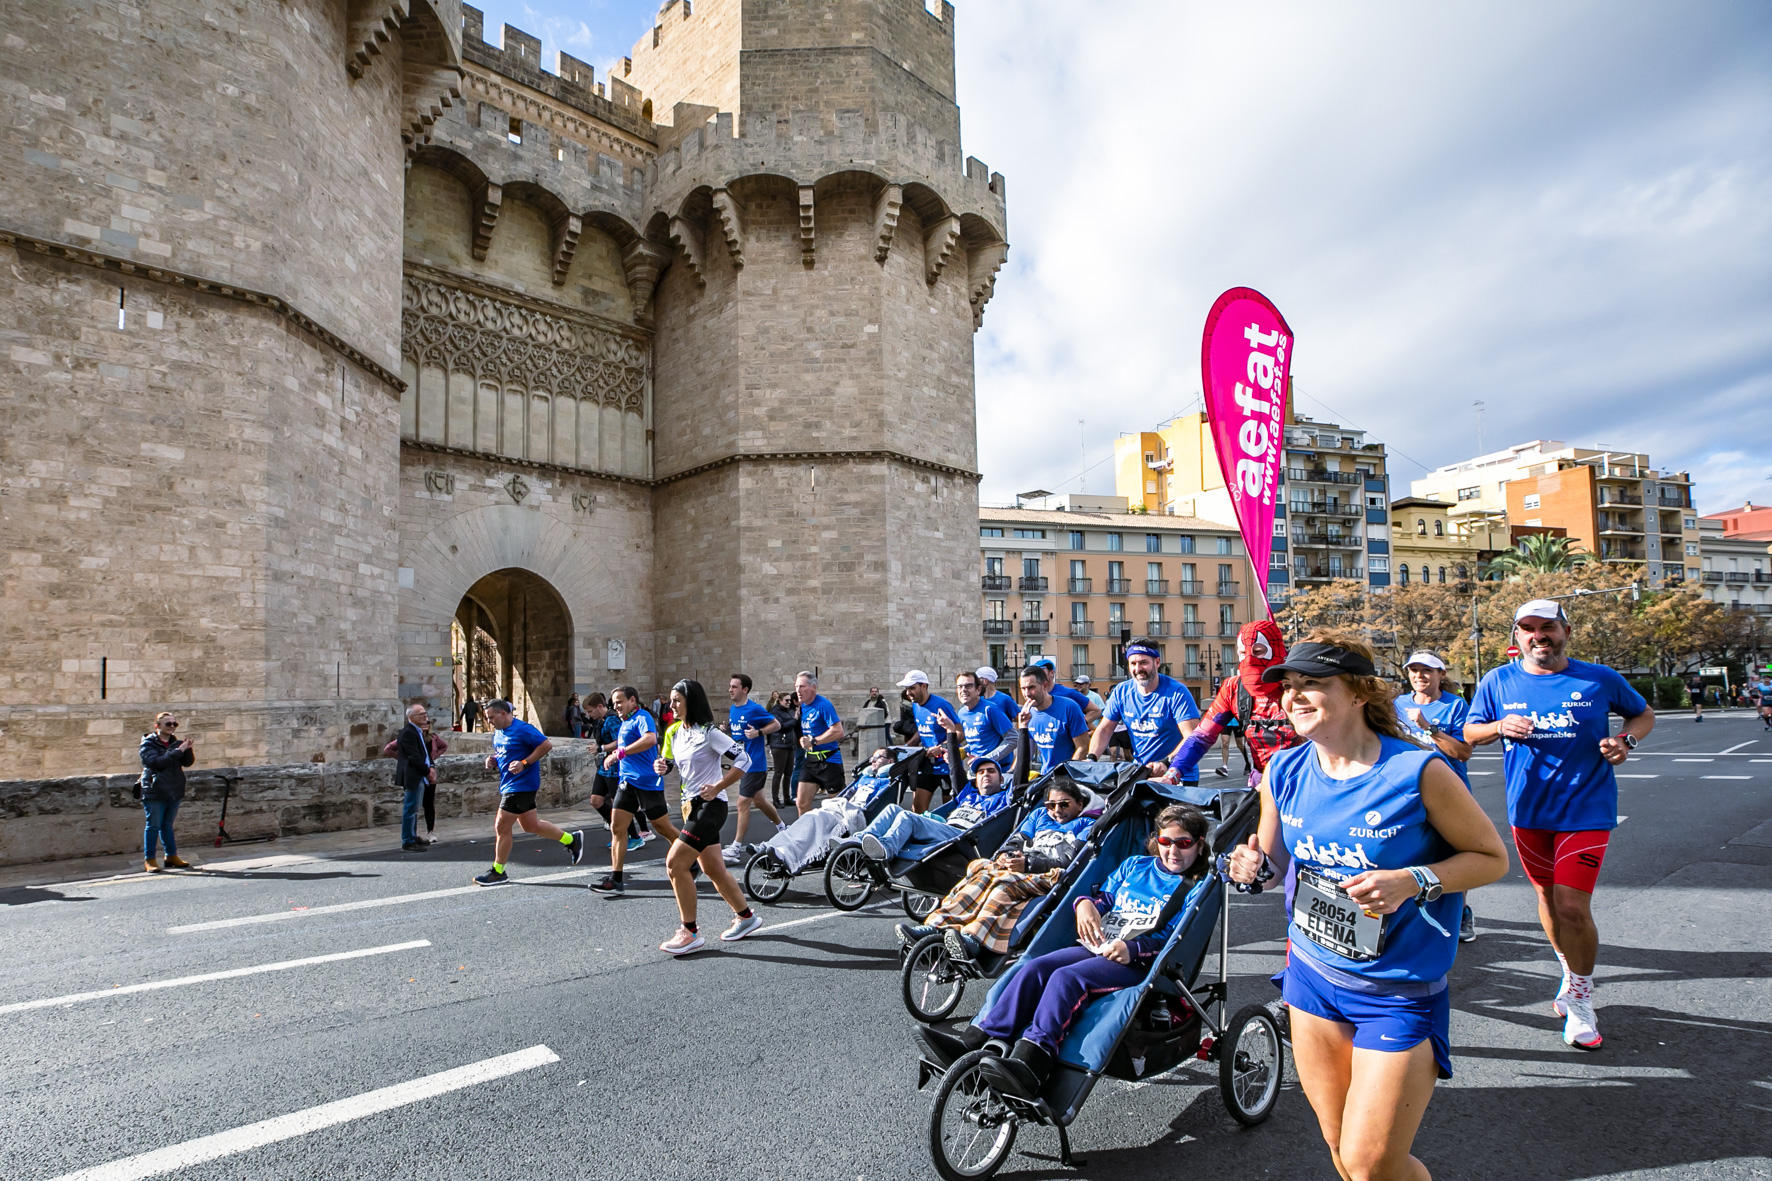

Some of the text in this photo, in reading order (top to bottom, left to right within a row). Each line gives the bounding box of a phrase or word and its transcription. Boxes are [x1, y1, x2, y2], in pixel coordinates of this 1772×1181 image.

[1235, 322, 1279, 498] aefat
[1262, 333, 1287, 506] www.aefat.es
[1316, 655, 1341, 665] ARTENGO
[1348, 826, 1397, 839] ZURICH
[1310, 897, 1357, 926] 28054
[1307, 911, 1357, 948] ELENA
